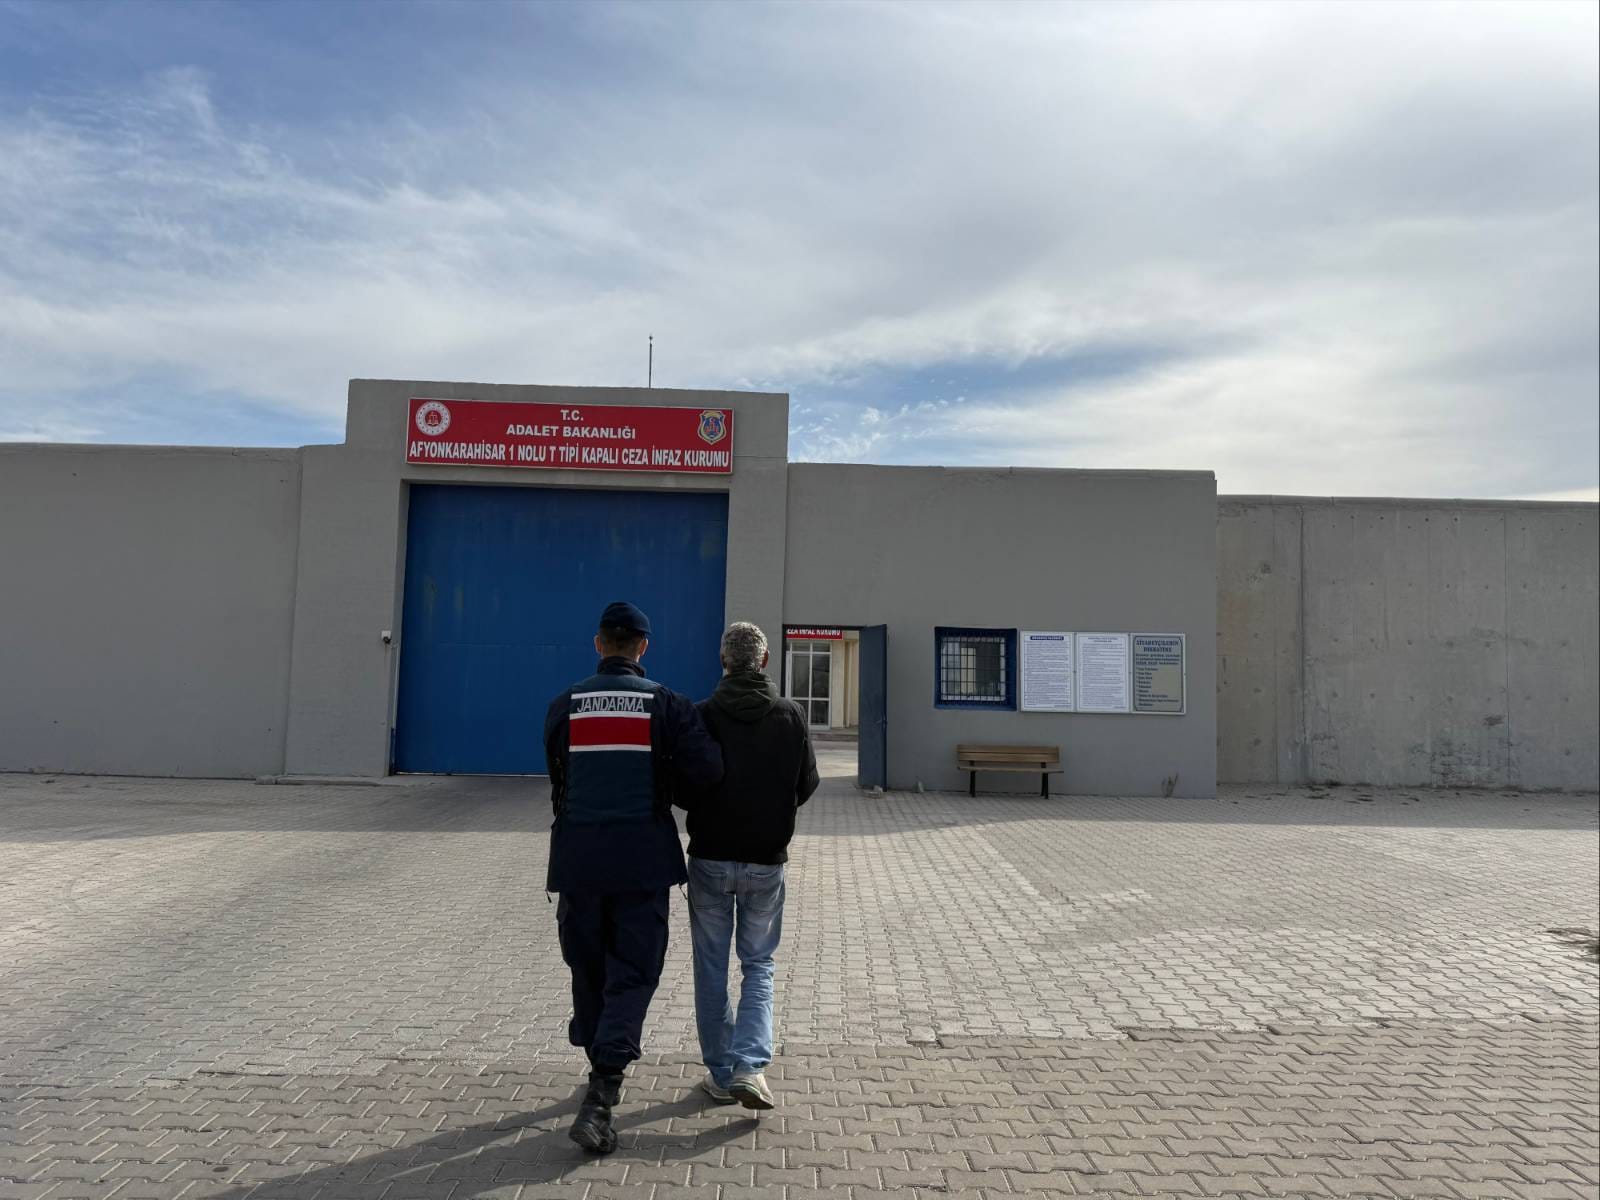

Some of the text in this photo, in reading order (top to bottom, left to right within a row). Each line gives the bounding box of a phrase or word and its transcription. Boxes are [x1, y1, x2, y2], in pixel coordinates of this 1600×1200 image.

[560, 409, 584, 421] T.C.
[506, 424, 636, 439] ADALET BAKANLIĞI
[409, 440, 729, 467] AFYONKARAHİSAR 1 NOLU T TİPİ KAPALI CEZA İNFAZ KURUMU
[577, 696, 645, 712] JANDARMA
